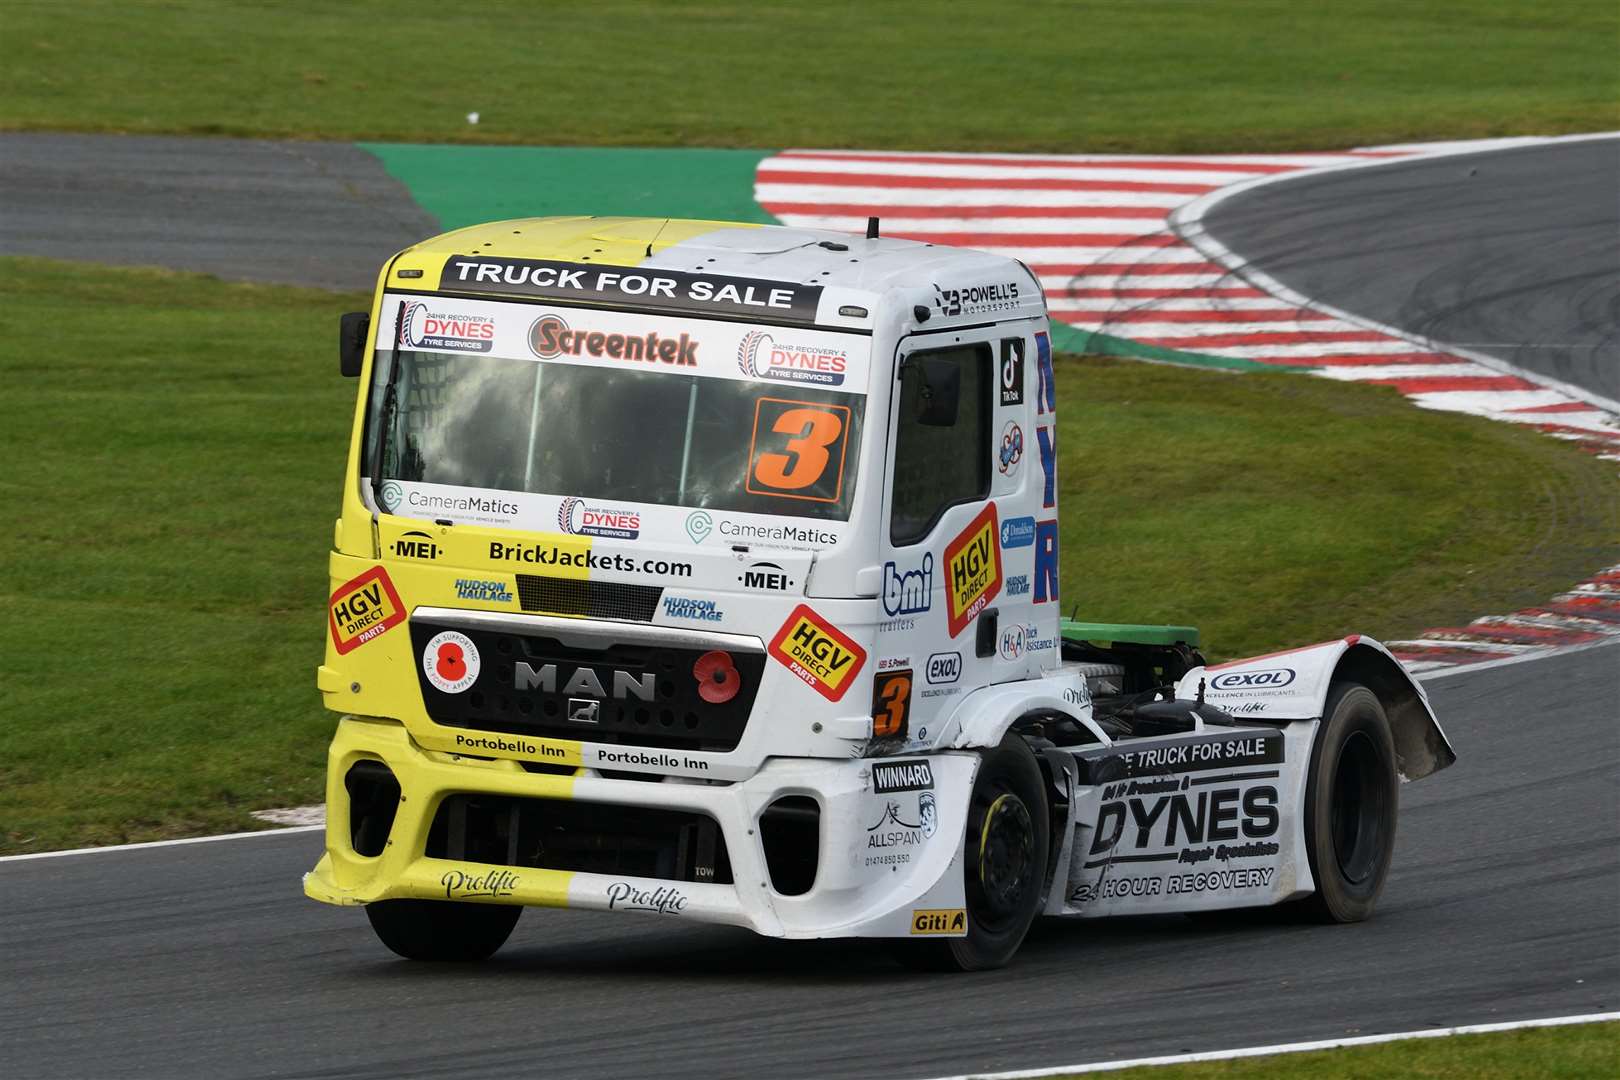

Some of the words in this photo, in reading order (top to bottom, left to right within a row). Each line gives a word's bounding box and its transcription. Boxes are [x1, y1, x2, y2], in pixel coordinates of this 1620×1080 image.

[455, 262, 587, 289] TRUCK
[595, 272, 676, 298] FOR
[688, 280, 796, 309] SALE
[962, 282, 1019, 304] POWELL'S
[448, 314, 488, 323] RECOVERY
[963, 300, 1020, 315] MOTORSPORT
[424, 319, 494, 339] DYNES
[423, 338, 442, 347] TYRE
[444, 340, 482, 350] SERVICES
[539, 319, 700, 367] Screentek
[796, 346, 840, 356] RECOVERY
[770, 350, 846, 373] DYNES
[770, 369, 790, 378] TYRE
[792, 371, 833, 382] SERVICES
[1003, 390, 1019, 402] TikTok
[754, 408, 842, 489] 3
[408, 491, 519, 515] CameraMatics
[601, 508, 636, 517] RECOVERY
[583, 512, 640, 529] DYNES
[600, 529, 631, 538] SERVICES
[719, 520, 838, 545] CameraMatics
[395, 540, 437, 560] MEI
[489, 541, 692, 577] BrickJackets.com
[953, 528, 990, 593] HGV
[454, 578, 506, 593] HUDSON
[744, 571, 787, 590] MEI
[883, 551, 934, 617] bmi
[961, 568, 988, 606] DIRECT
[334, 583, 382, 626] HGV
[457, 589, 513, 602] HAULAGE
[663, 596, 716, 611] HUDSON
[665, 607, 723, 622] HAULAGE
[967, 594, 986, 621] PARTS
[346, 607, 385, 634] DIRECT
[358, 623, 386, 643] PARTS
[442, 633, 478, 662] SUPPORTING
[792, 622, 851, 671] HGV
[1003, 632, 1022, 658] H&A
[789, 661, 817, 685] PARTS
[791, 645, 832, 678] DIRECT
[452, 672, 475, 690] APPEAL
[514, 661, 656, 702] MAN
[1205, 691, 1245, 699] XCELLENCE
[1254, 689, 1297, 698] LUBRICANTS
[874, 676, 910, 737] 3
[456, 734, 536, 755] Portobello
[541, 743, 566, 758] Inn
[1138, 746, 1189, 768] TRUCK
[1191, 742, 1222, 762] FOR
[1225, 738, 1266, 758] SALE
[598, 750, 679, 769] Portobello
[683, 757, 709, 771] Inn
[876, 764, 931, 788] WINNARD
[1089, 785, 1280, 856] DYNES
[868, 831, 920, 848] ALLSPAN
[695, 866, 714, 876] TOW
[865, 856, 884, 867] 01474
[884, 855, 896, 865] 850
[897, 854, 911, 864] 550
[440, 869, 521, 898] Prolific
[1103, 877, 1162, 899] HOUR
[1167, 867, 1275, 894] RECOVERY
[607, 882, 689, 915] Prolific
[915, 914, 947, 931] Giti
